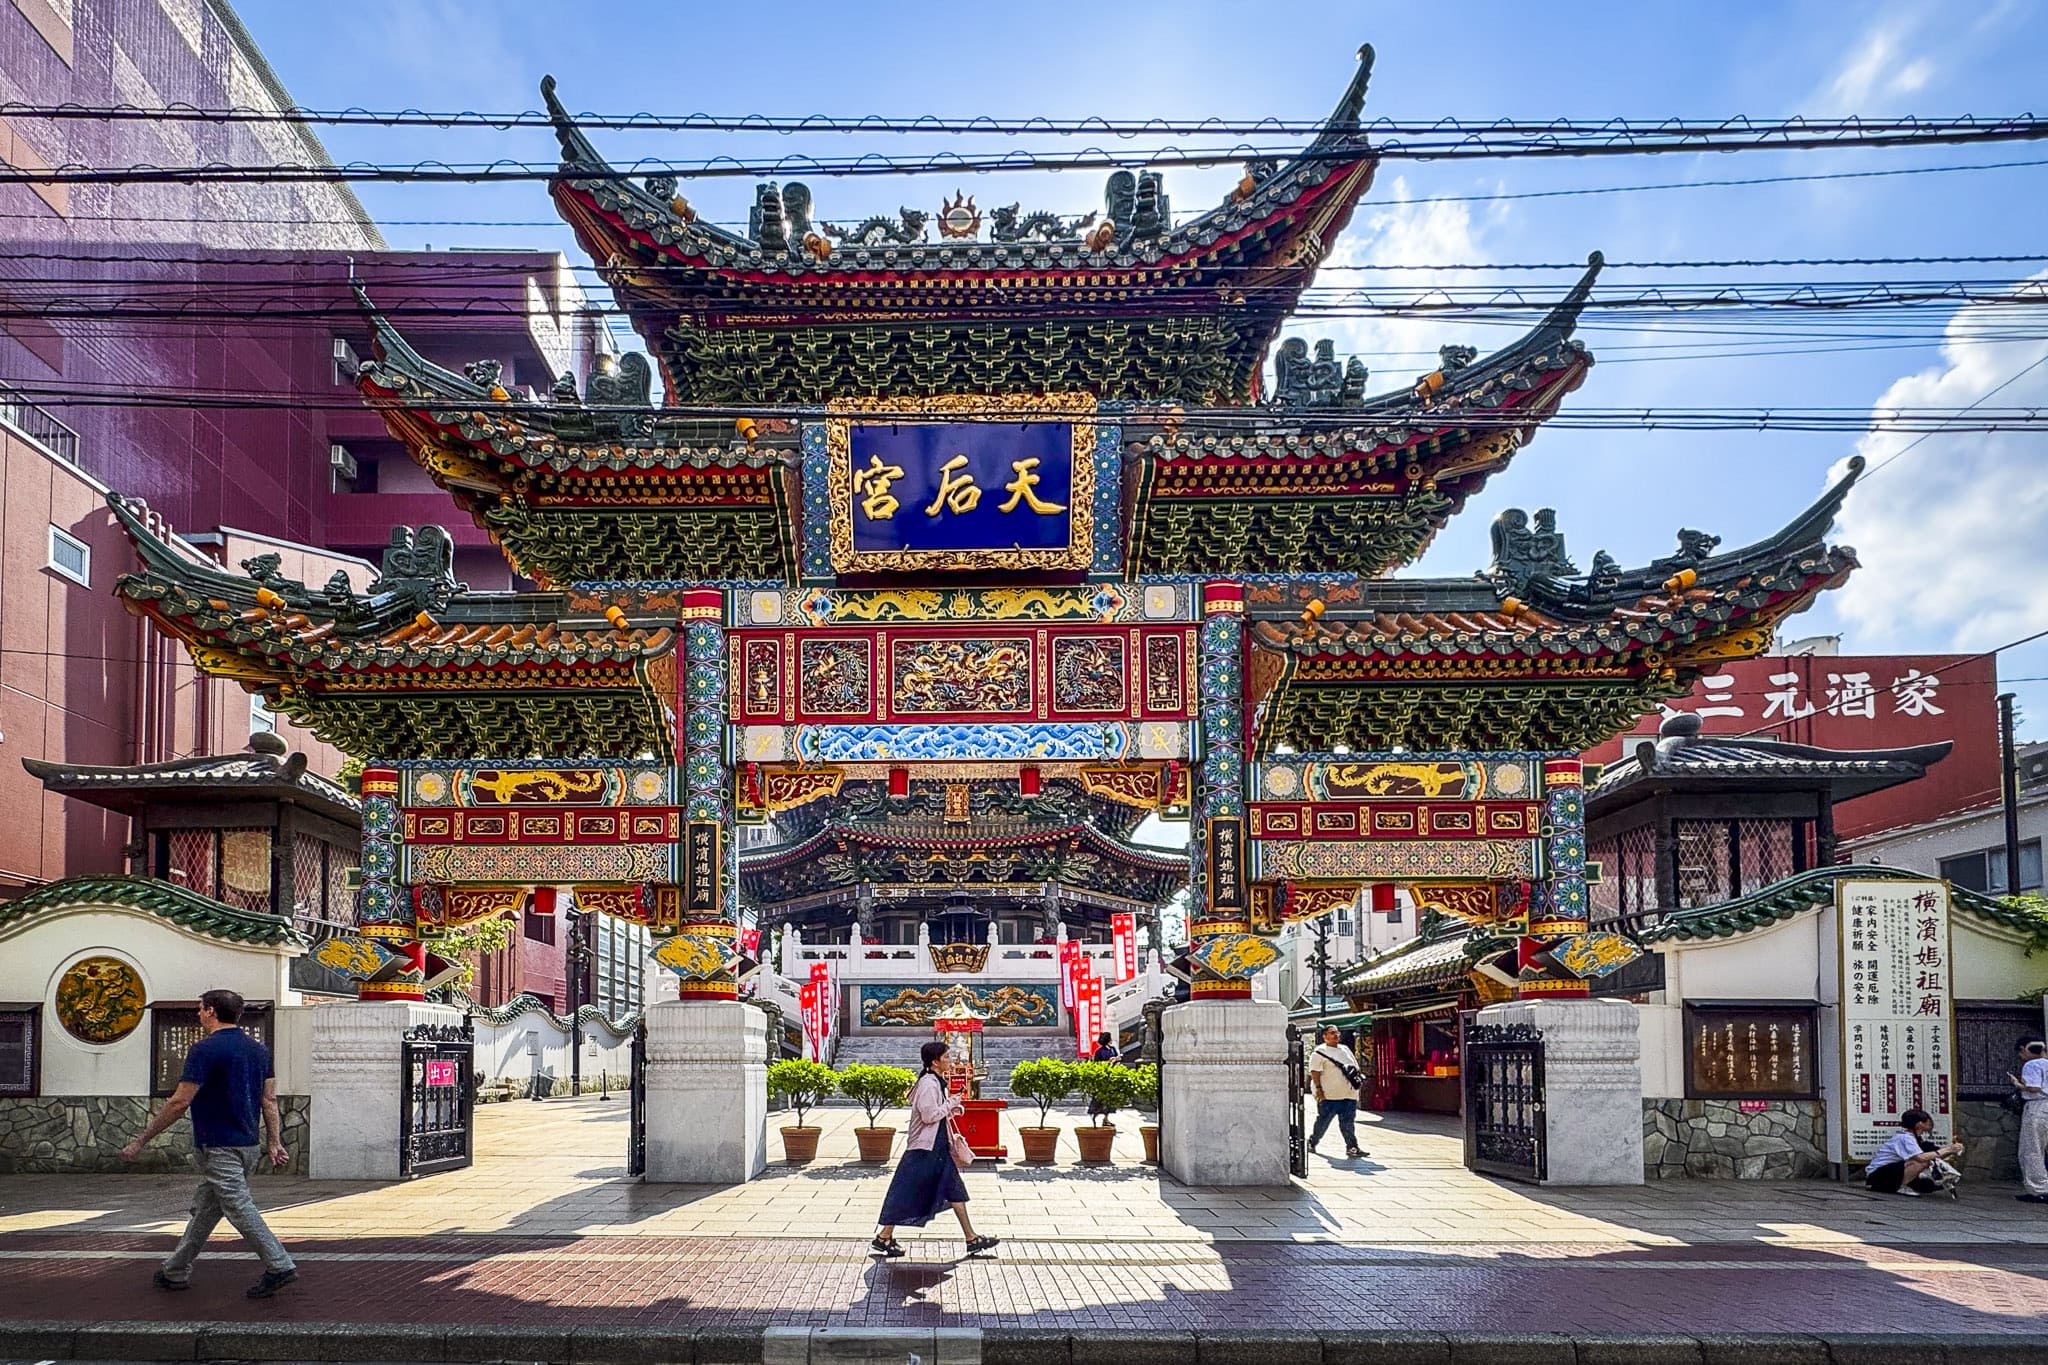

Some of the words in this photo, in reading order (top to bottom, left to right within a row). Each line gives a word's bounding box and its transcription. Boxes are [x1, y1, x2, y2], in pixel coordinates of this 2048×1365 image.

[1655, 669, 1945, 720] 三元酒家
[1851, 905, 1864, 951] 健康祈願
[1865, 905, 1879, 952] 家内安全
[1852, 960, 1865, 1005] 旅の安全
[430, 1065, 452, 1080] 出口
